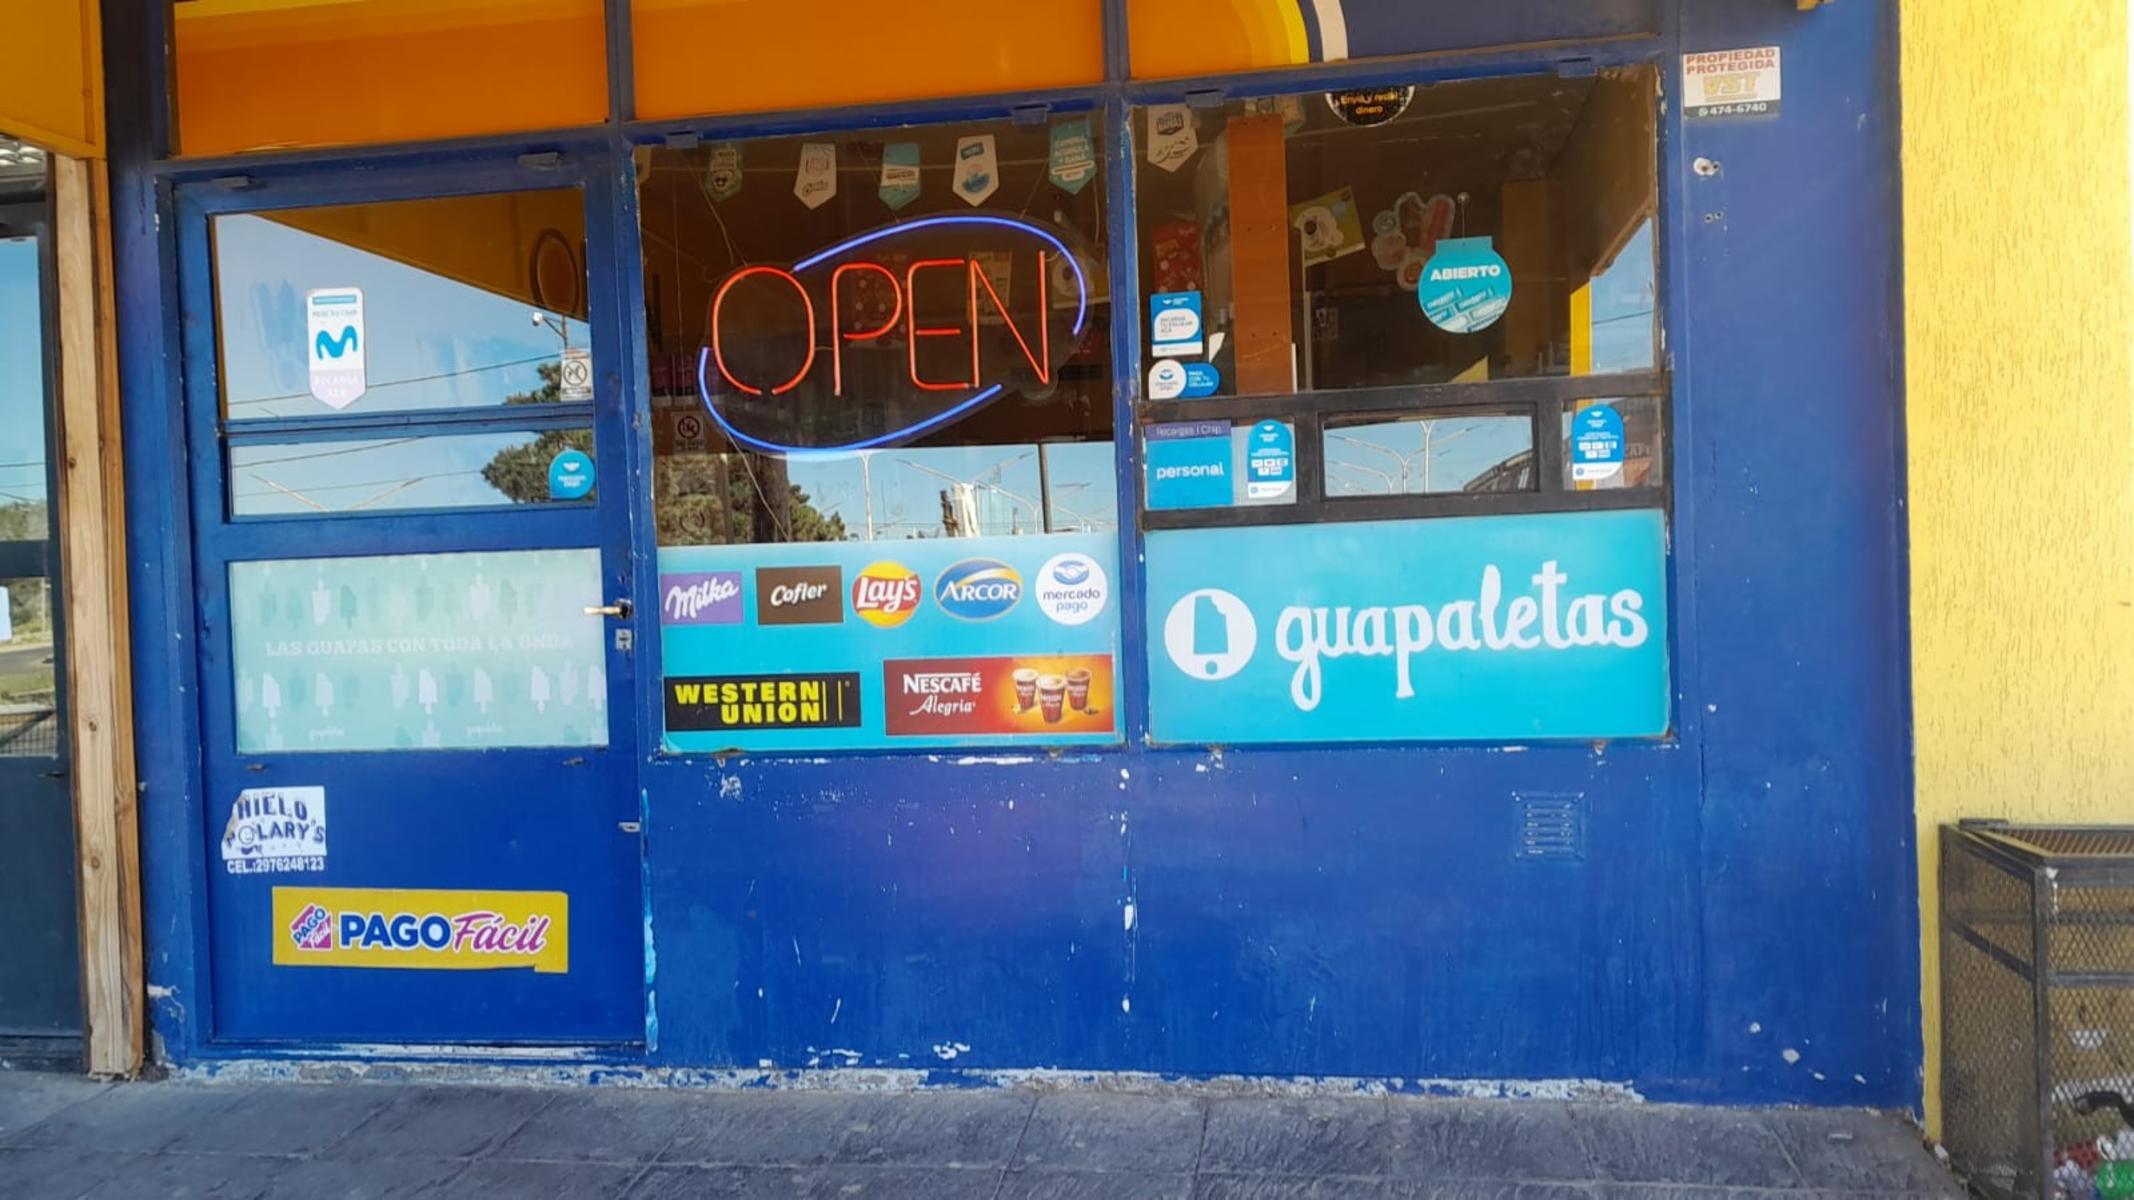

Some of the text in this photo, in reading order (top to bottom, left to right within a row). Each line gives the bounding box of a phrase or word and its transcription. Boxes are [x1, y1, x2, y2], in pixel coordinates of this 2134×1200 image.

[1686, 49, 1775, 65] PROPIEDAD
[1686, 59, 1775, 75] PROTEGIDA
[1710, 102, 1767, 115] 474-6740
[1430, 264, 1501, 282] ABIERTO
[712, 250, 1050, 397] OPEN
[1156, 461, 1225, 480] personal
[665, 577, 740, 620] Milka
[770, 582, 828, 607] Cofler
[856, 576, 918, 613] Lay's
[940, 581, 1018, 603] ARCOR
[1043, 588, 1101, 602] mercado
[1056, 599, 1089, 614] pago
[266, 641, 302, 657] LAS
[307, 639, 382, 655] GUAPAS
[387, 638, 425, 654] CON
[430, 637, 481, 652] TODA
[488, 635, 514, 651] LA
[1275, 560, 1649, 712] guapaletas
[674, 681, 820, 704] WESTERN
[903, 672, 982, 694] NESCAFÉ
[721, 701, 820, 724] UNION
[237, 794, 308, 821] HIELO
[293, 907, 326, 943] PAGO
[340, 911, 550, 952] PAGO Fácil
